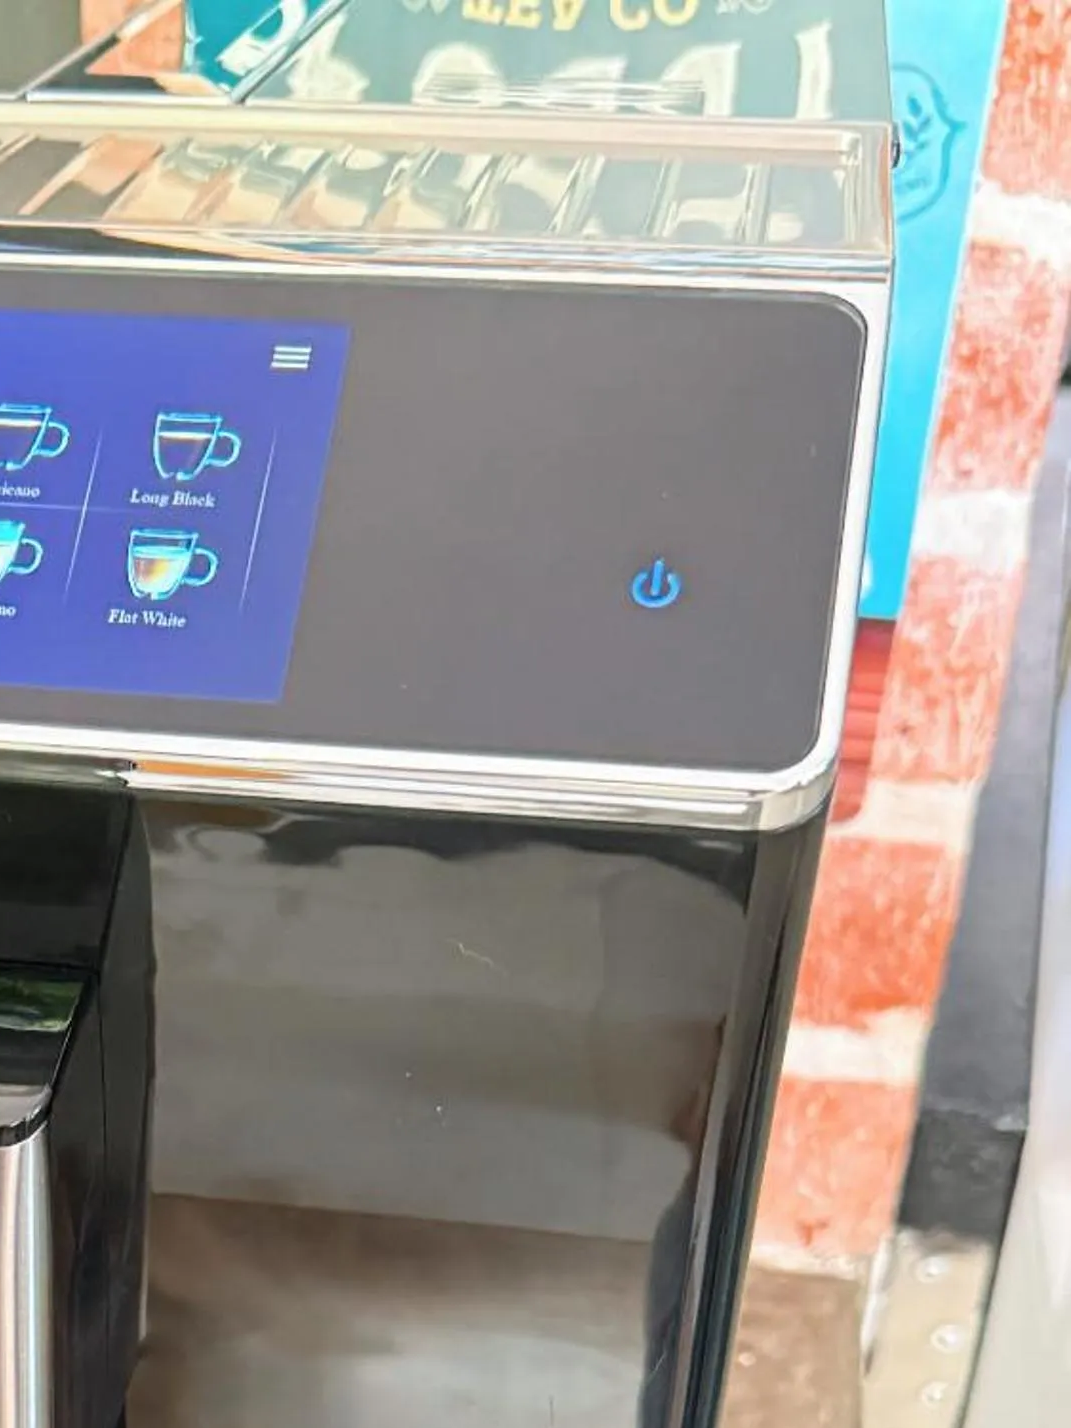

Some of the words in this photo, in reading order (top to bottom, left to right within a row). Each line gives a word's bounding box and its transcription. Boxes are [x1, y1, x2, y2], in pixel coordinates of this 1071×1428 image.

[130, 488, 170, 507] Long
[172, 490, 216, 508] Black
[108, 608, 138, 625] Flat
[142, 610, 188, 628] White
